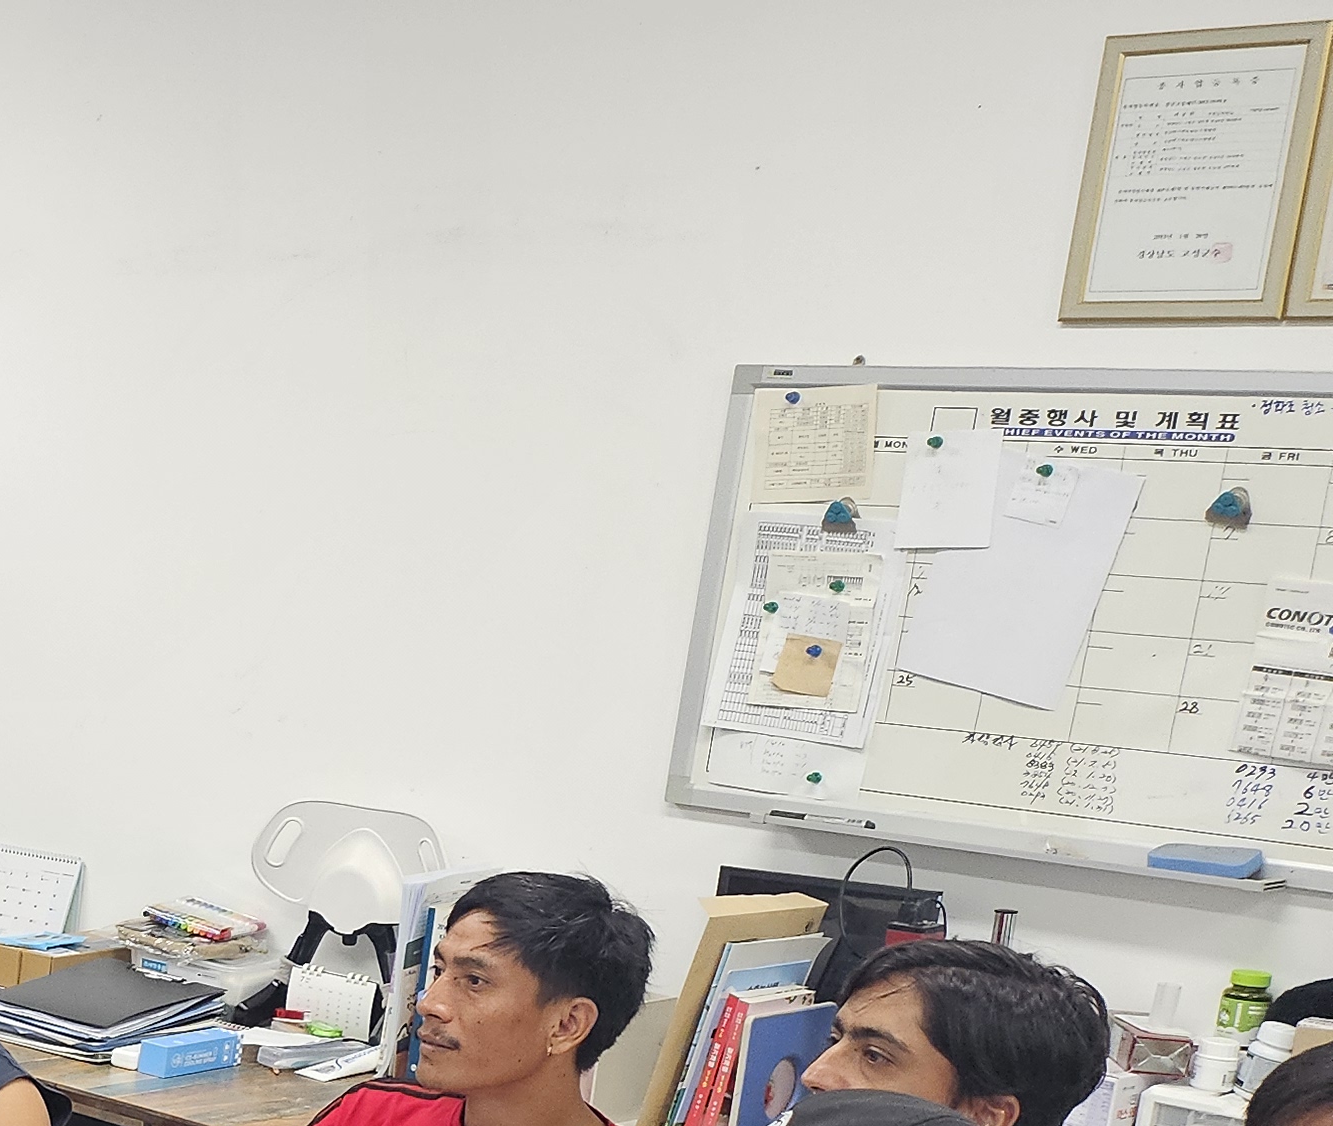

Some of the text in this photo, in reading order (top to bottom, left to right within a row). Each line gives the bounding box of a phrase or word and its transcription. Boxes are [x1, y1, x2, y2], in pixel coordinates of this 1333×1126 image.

[990, 407, 1241, 431] 월중행사 및 계획표
[1004, 427, 1233, 442] HIEF EVENTS OF THE MONTH
[1070, 444, 1098, 455] WED
[1171, 448, 1199, 458] THU
[1261, 451, 1300, 461] 금 FRI
[896, 674, 915, 686] 25
[1179, 701, 1201, 715] 28
